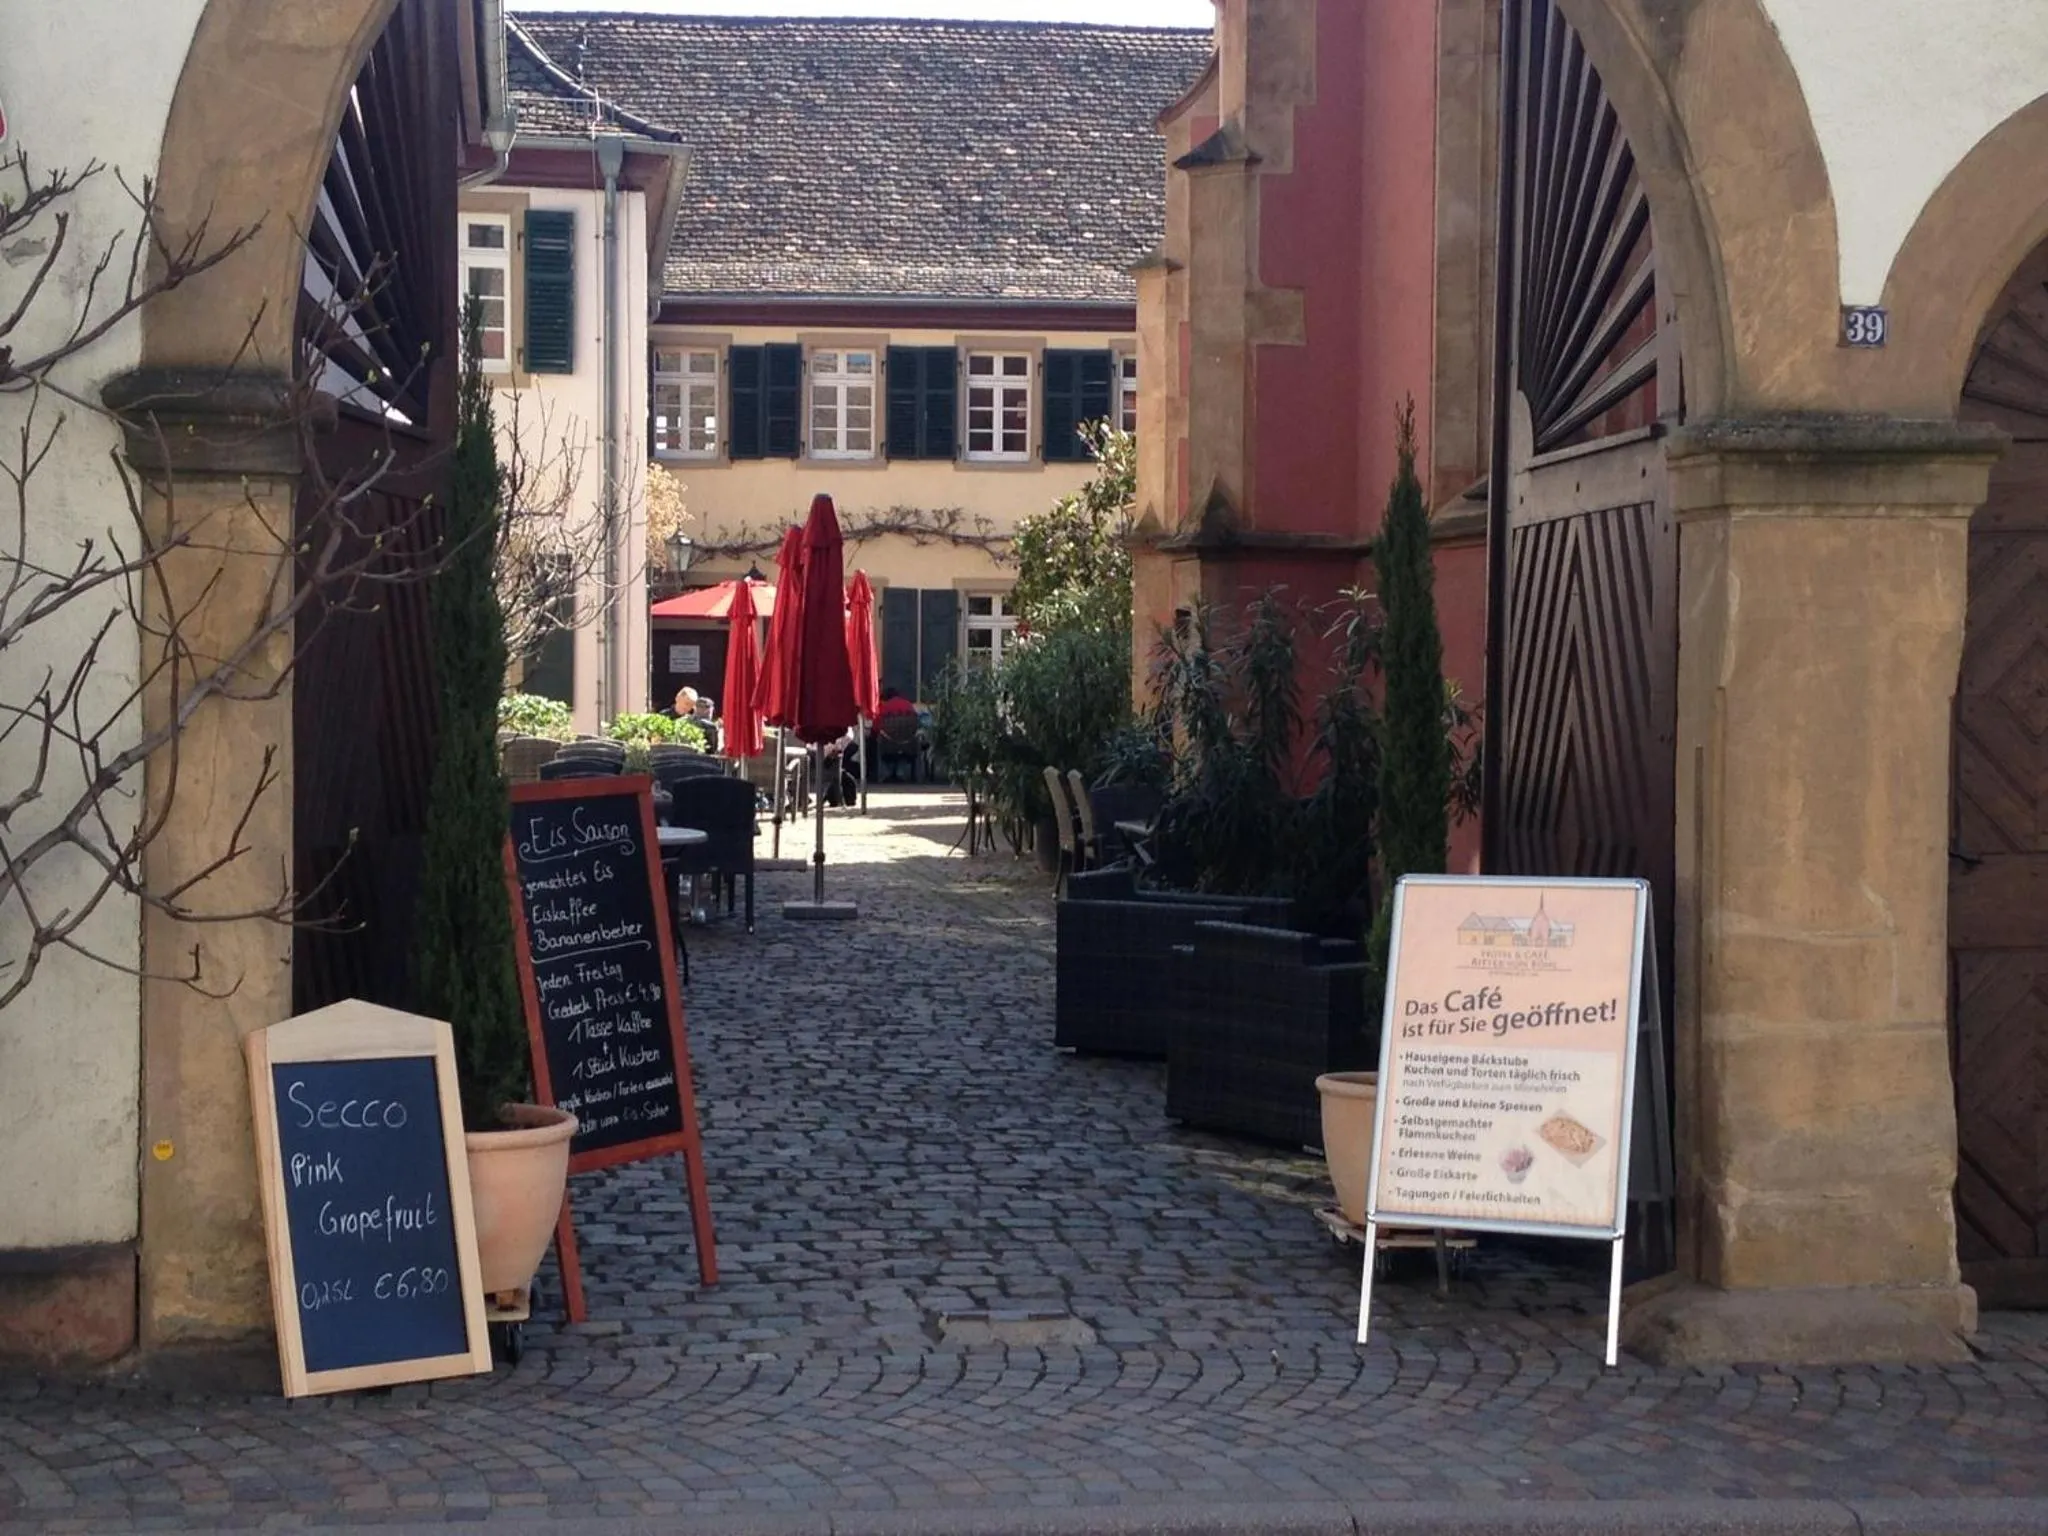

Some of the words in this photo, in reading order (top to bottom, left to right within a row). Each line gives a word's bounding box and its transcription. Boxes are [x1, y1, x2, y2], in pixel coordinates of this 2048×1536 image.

[1846, 312, 1883, 342] 39
[530, 817, 567, 853] Eis
[572, 806, 631, 844] Saison
[593, 860, 614, 882] Eis
[532, 897, 598, 926] Eiskaffee
[534, 919, 643, 951] Bananenbecher
[575, 960, 624, 984] Freitag
[548, 994, 591, 1020] Gedeck
[1404, 1000, 1438, 1017] Das
[1444, 986, 1503, 1013] Café
[580, 1017, 614, 1039] Tasse
[616, 1011, 653, 1034] Kaffee
[1402, 1020, 1424, 1038] ist
[1428, 1018, 1455, 1036] für
[1460, 1017, 1487, 1034] Sie
[1492, 999, 1618, 1037] geöffnet!
[584, 1051, 617, 1079] Stück
[619, 1045, 661, 1067] Kuchen
[1404, 1051, 1469, 1066] Hauseigene
[1404, 1064, 1445, 1076] Kuchen
[1446, 1066, 1469, 1077] und
[1471, 1067, 1507, 1079] Torten
[1508, 1068, 1548, 1082] täglich
[1549, 1070, 1581, 1082] frisch
[288, 1081, 408, 1129] Secco
[1402, 1095, 1436, 1108] Große
[1438, 1097, 1461, 1109] und
[1462, 1098, 1497, 1110] kleine
[1499, 1101, 1544, 1114] Speisen
[1398, 1127, 1476, 1142] Flammkuchen
[1400, 1115, 1493, 1130] Selbstgemachter
[1398, 1148, 1446, 1161] Erlesene
[1447, 1149, 1482, 1162] Weine
[290, 1151, 344, 1188] Pink
[1396, 1167, 1431, 1180] Große
[1433, 1169, 1479, 1181] Eiskarte
[1395, 1187, 1450, 1203] Tagungen
[1459, 1190, 1541, 1206] Feierlichkeiten
[318, 1191, 438, 1243] Grapefruit
